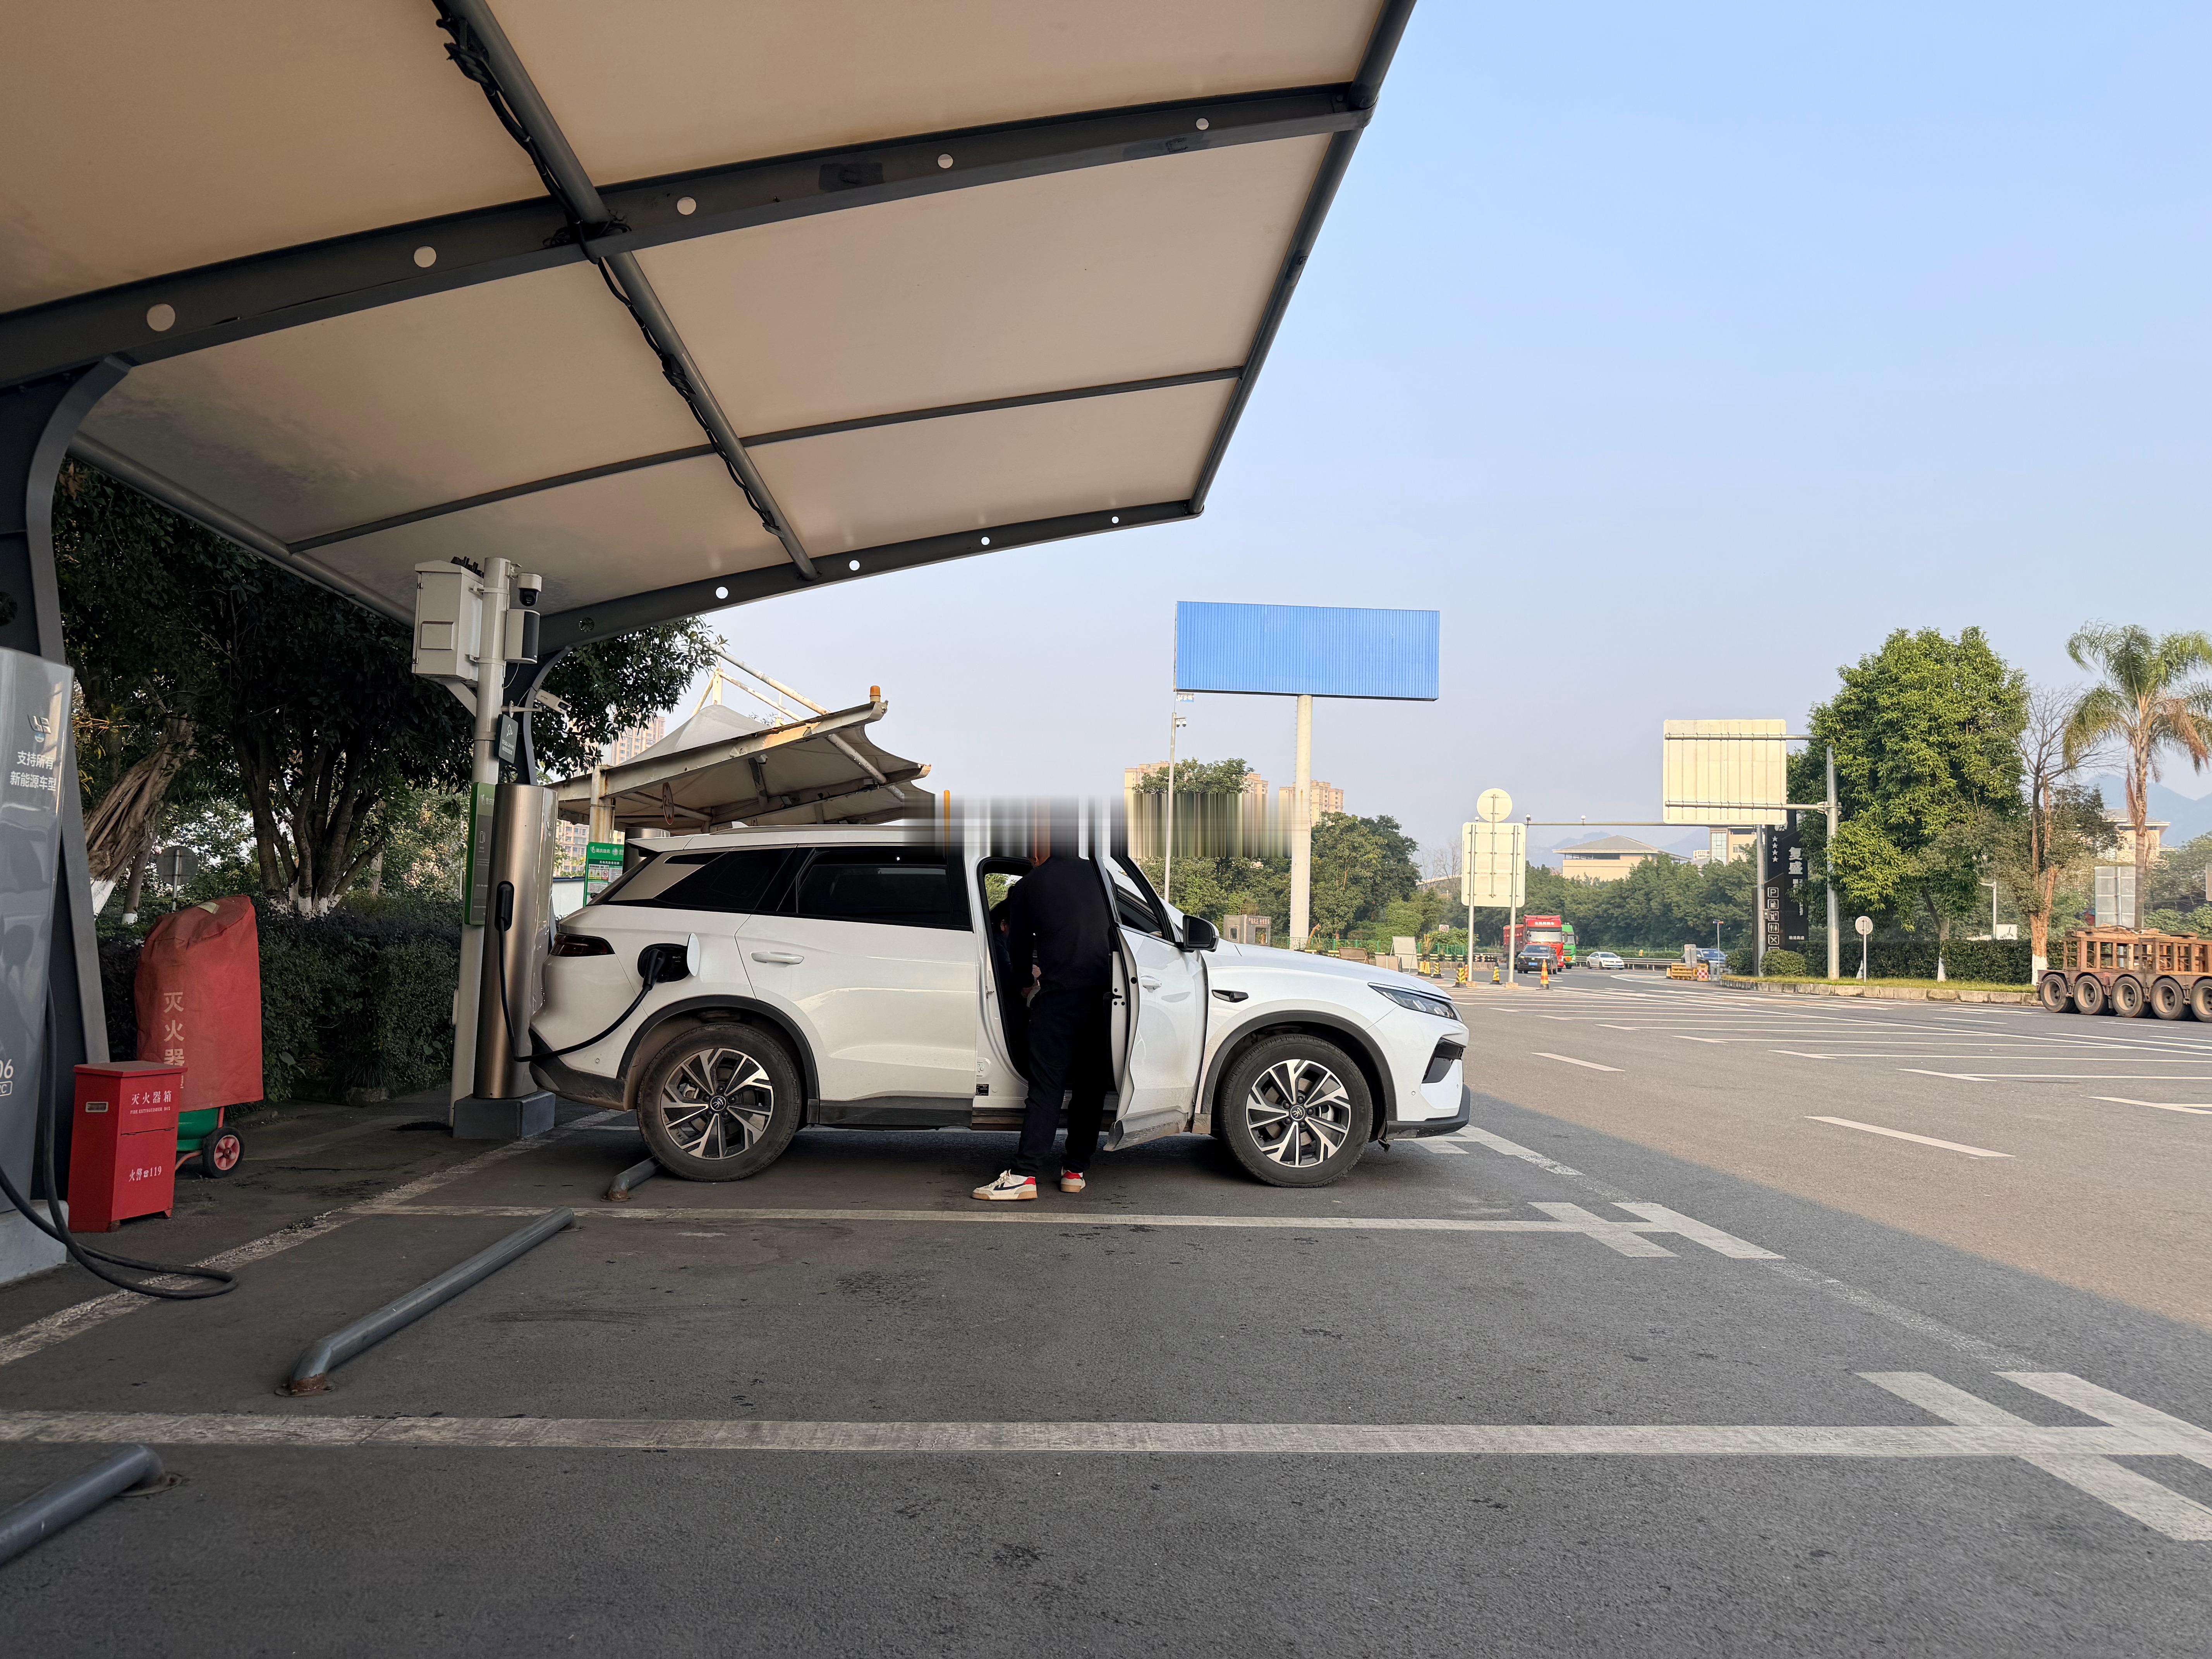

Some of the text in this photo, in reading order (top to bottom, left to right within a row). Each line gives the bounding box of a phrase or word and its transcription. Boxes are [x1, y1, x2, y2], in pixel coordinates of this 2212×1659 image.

[17, 750, 55, 769] 支持所有
[10, 771, 57, 791] 新能源车型
[163, 992, 185, 1089] 灭火器
[132, 1091, 172, 1105] 灭火器箱
[150, 1166, 162, 1176] 119
